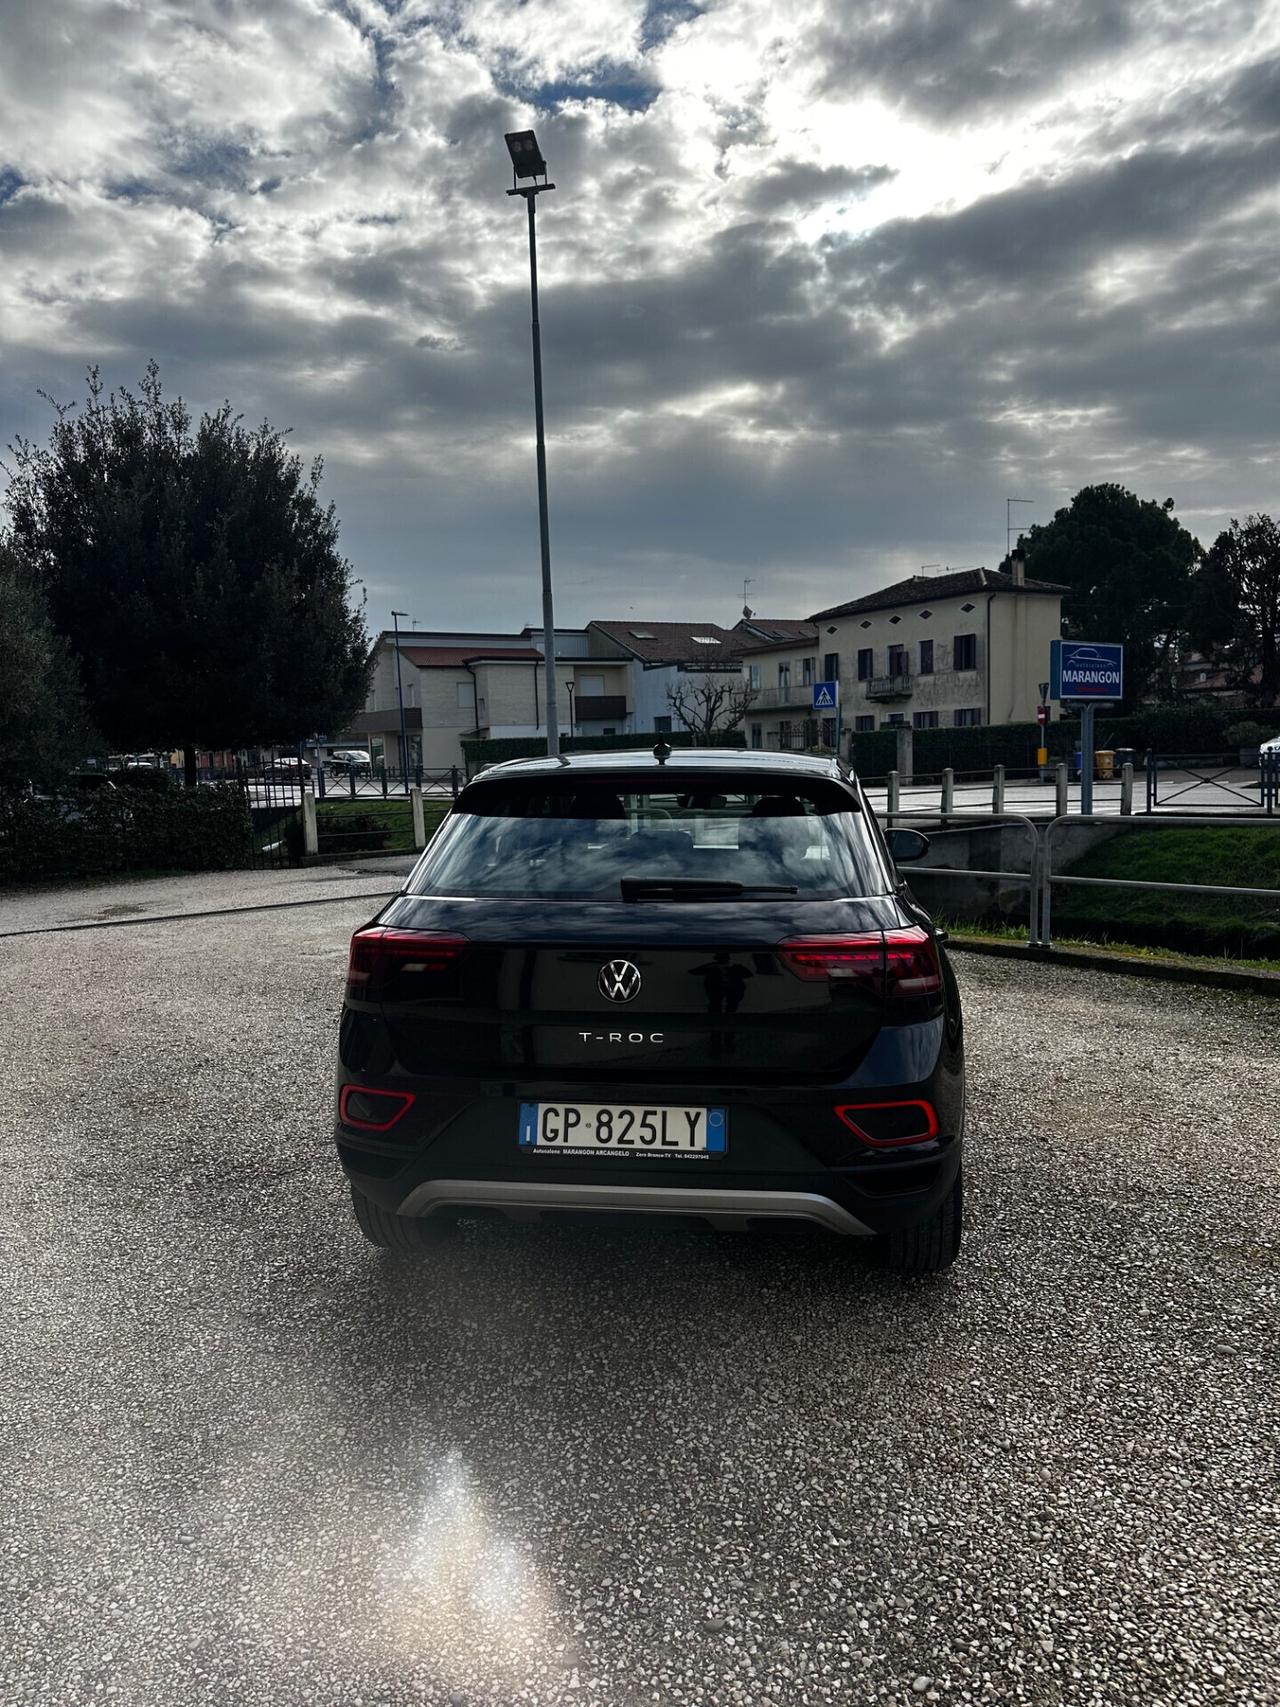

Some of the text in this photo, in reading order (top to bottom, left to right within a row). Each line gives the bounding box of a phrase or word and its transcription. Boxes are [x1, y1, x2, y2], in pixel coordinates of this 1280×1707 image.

[1062, 670, 1120, 684] MARANGON
[578, 1032, 664, 1043] T-ROC
[542, 1107, 702, 1147] GP 825LY
